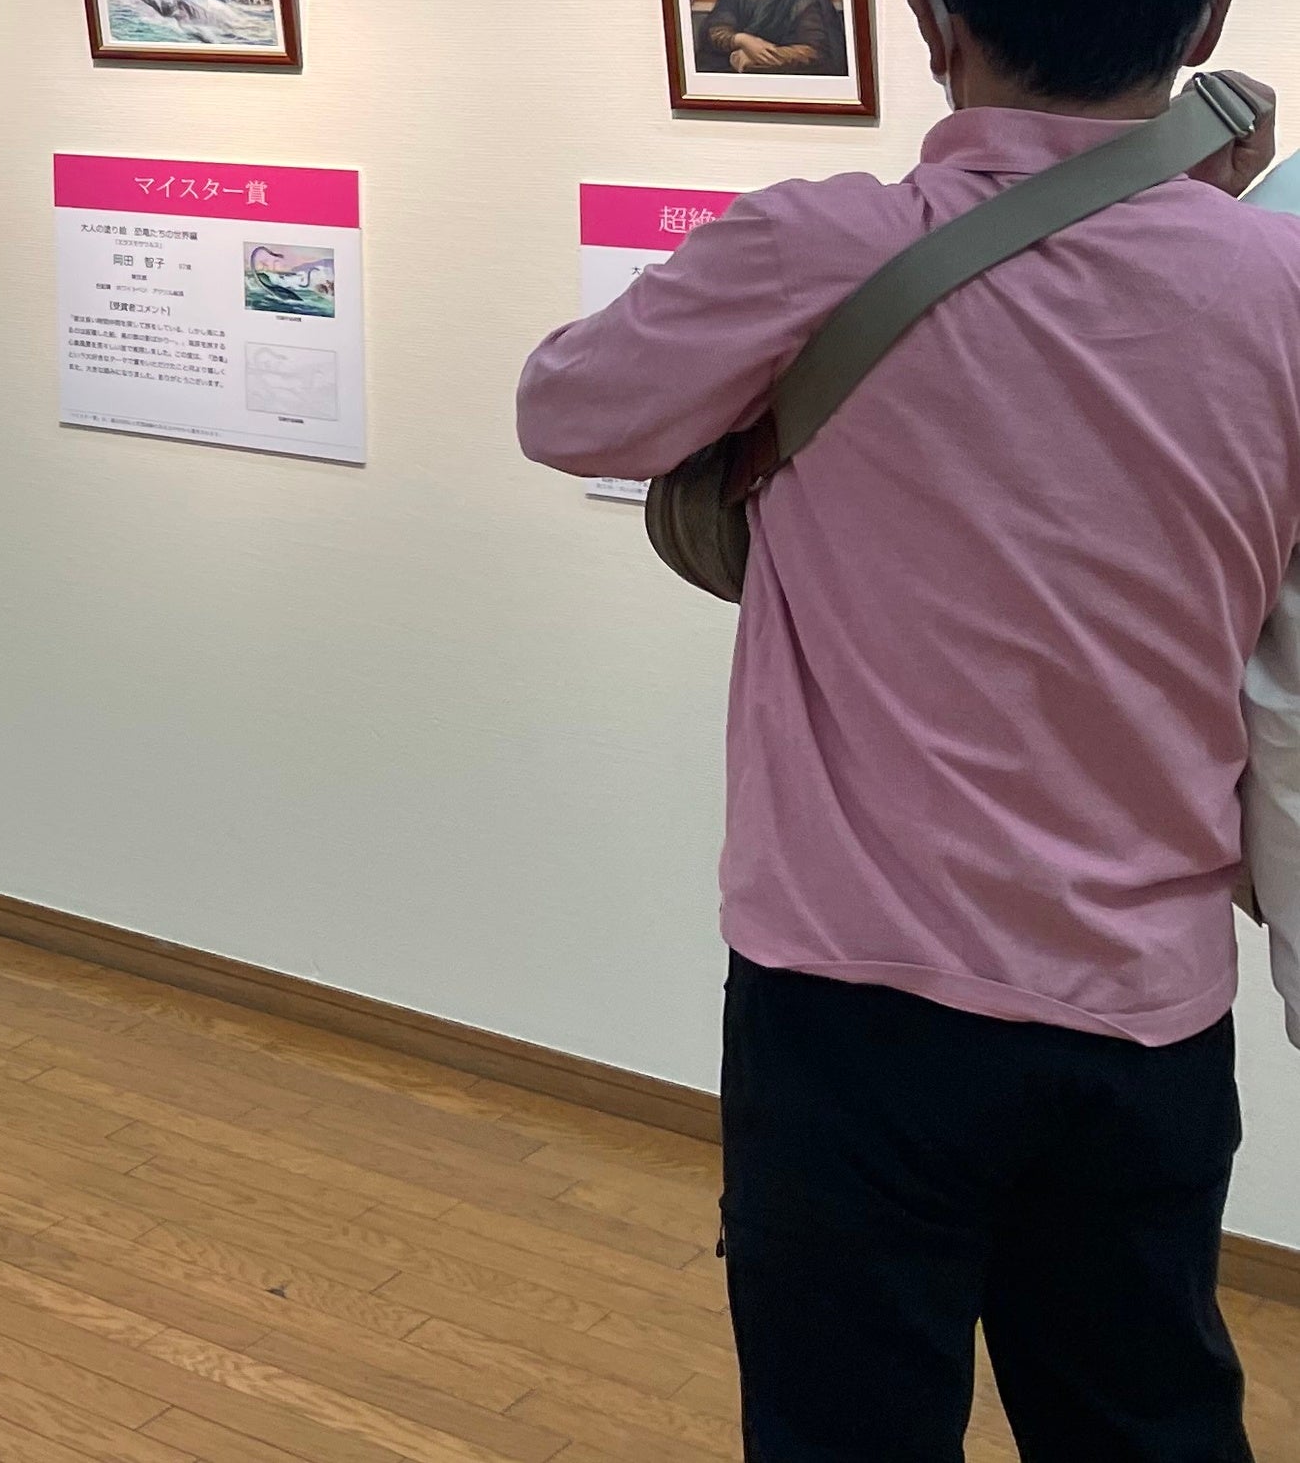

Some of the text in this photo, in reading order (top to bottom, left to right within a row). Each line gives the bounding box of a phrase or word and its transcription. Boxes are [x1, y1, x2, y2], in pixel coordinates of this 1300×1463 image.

[133, 174, 269, 207] マイスター賞
[80, 223, 128, 236] 大人の塗り絵
